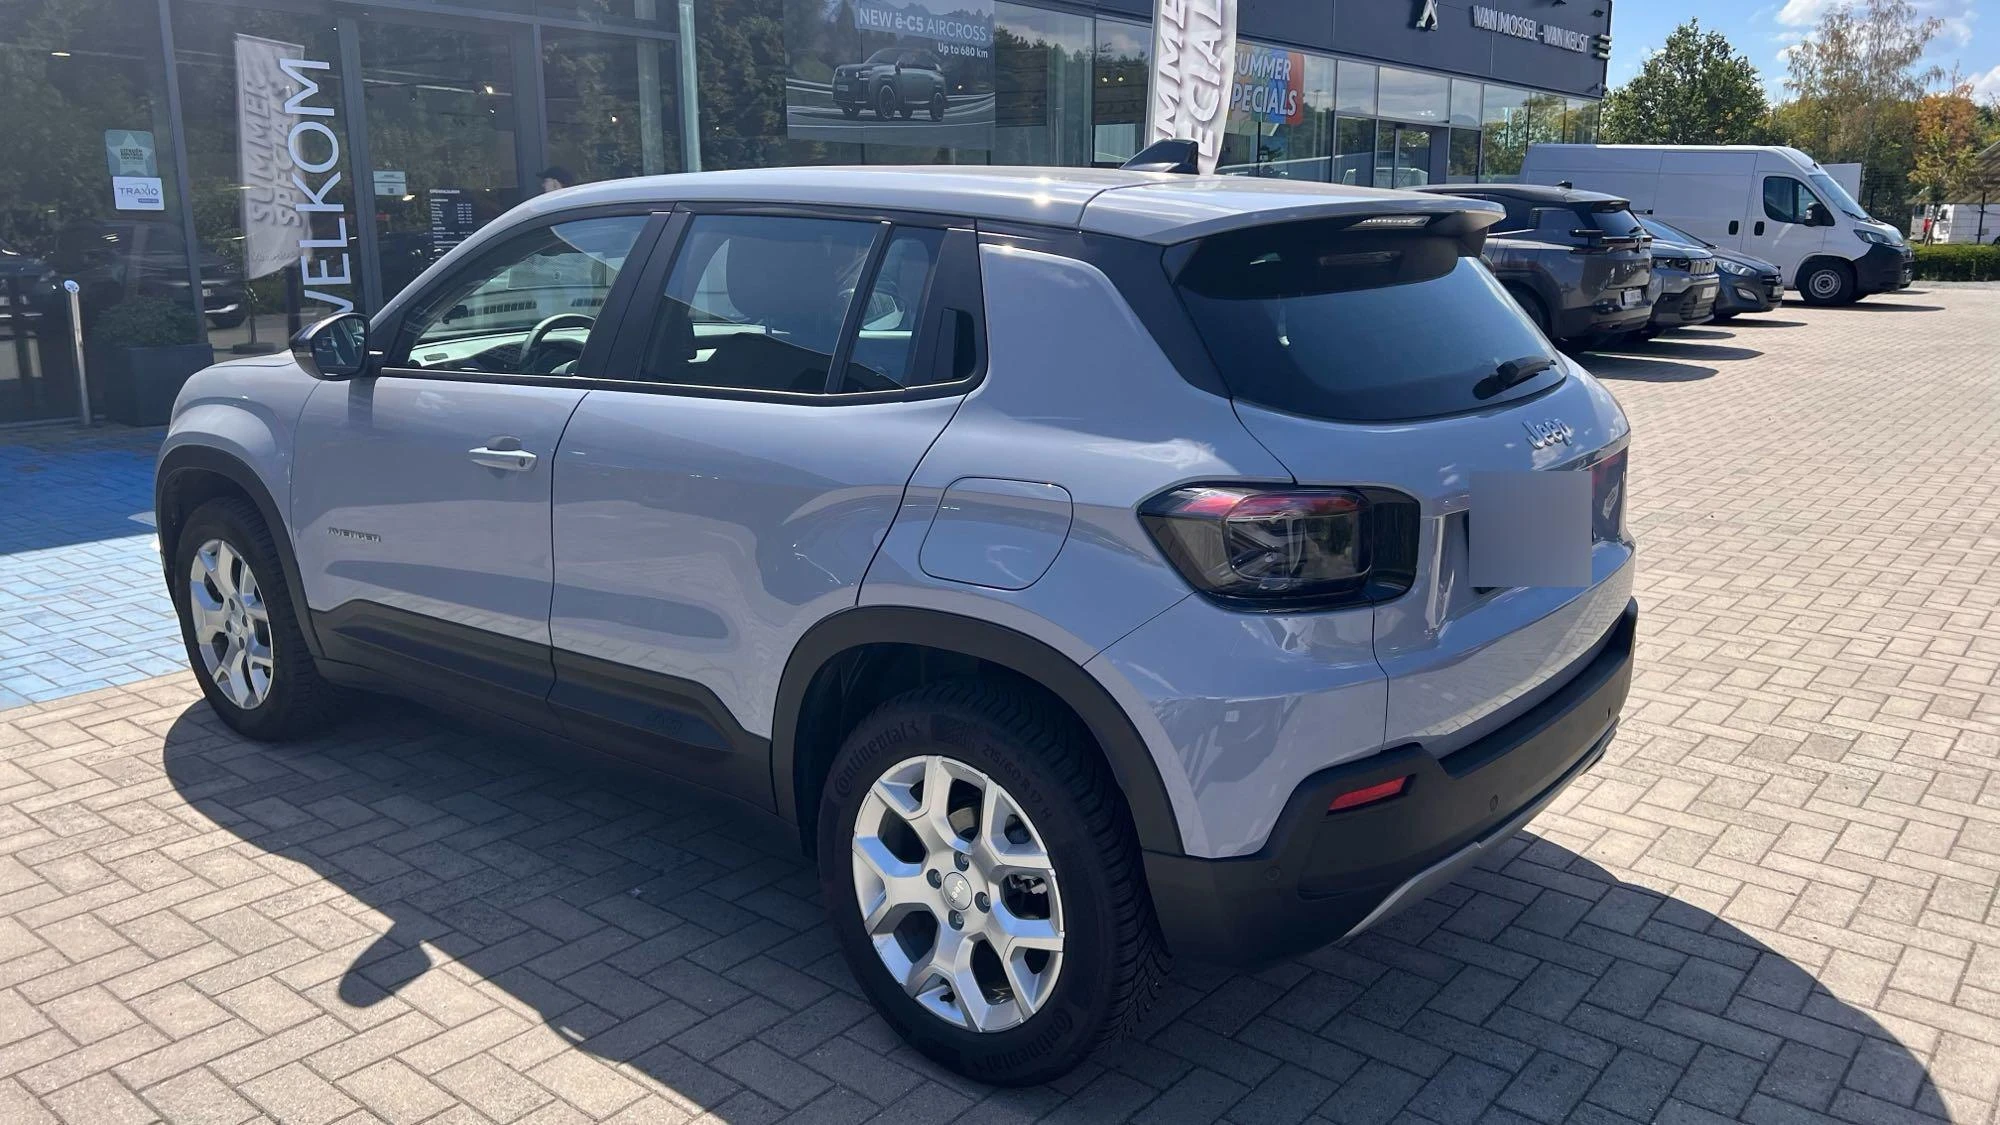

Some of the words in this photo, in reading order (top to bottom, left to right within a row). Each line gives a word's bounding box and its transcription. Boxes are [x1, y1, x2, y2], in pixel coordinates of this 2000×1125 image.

[860, 8, 892, 28] NEW
[926, 18, 987, 41] AIRCROSS
[1473, 5, 1497, 31] VAN
[1498, 11, 1538, 41] MOSSEL
[1543, 24, 1564, 46] VAN
[938, 42, 948, 55] Up
[950, 44, 959, 55] to
[960, 45, 975, 57] 680
[976, 47, 988, 59] km
[1180, 0, 1222, 157] ECIAL
[1231, 83, 1298, 116] PECIALS
[244, 79, 276, 224] SUMMER
[119, 185, 159, 196] TRAXIO
[1522, 418, 1574, 449] Jeep
[835, 721, 905, 797] Continental
